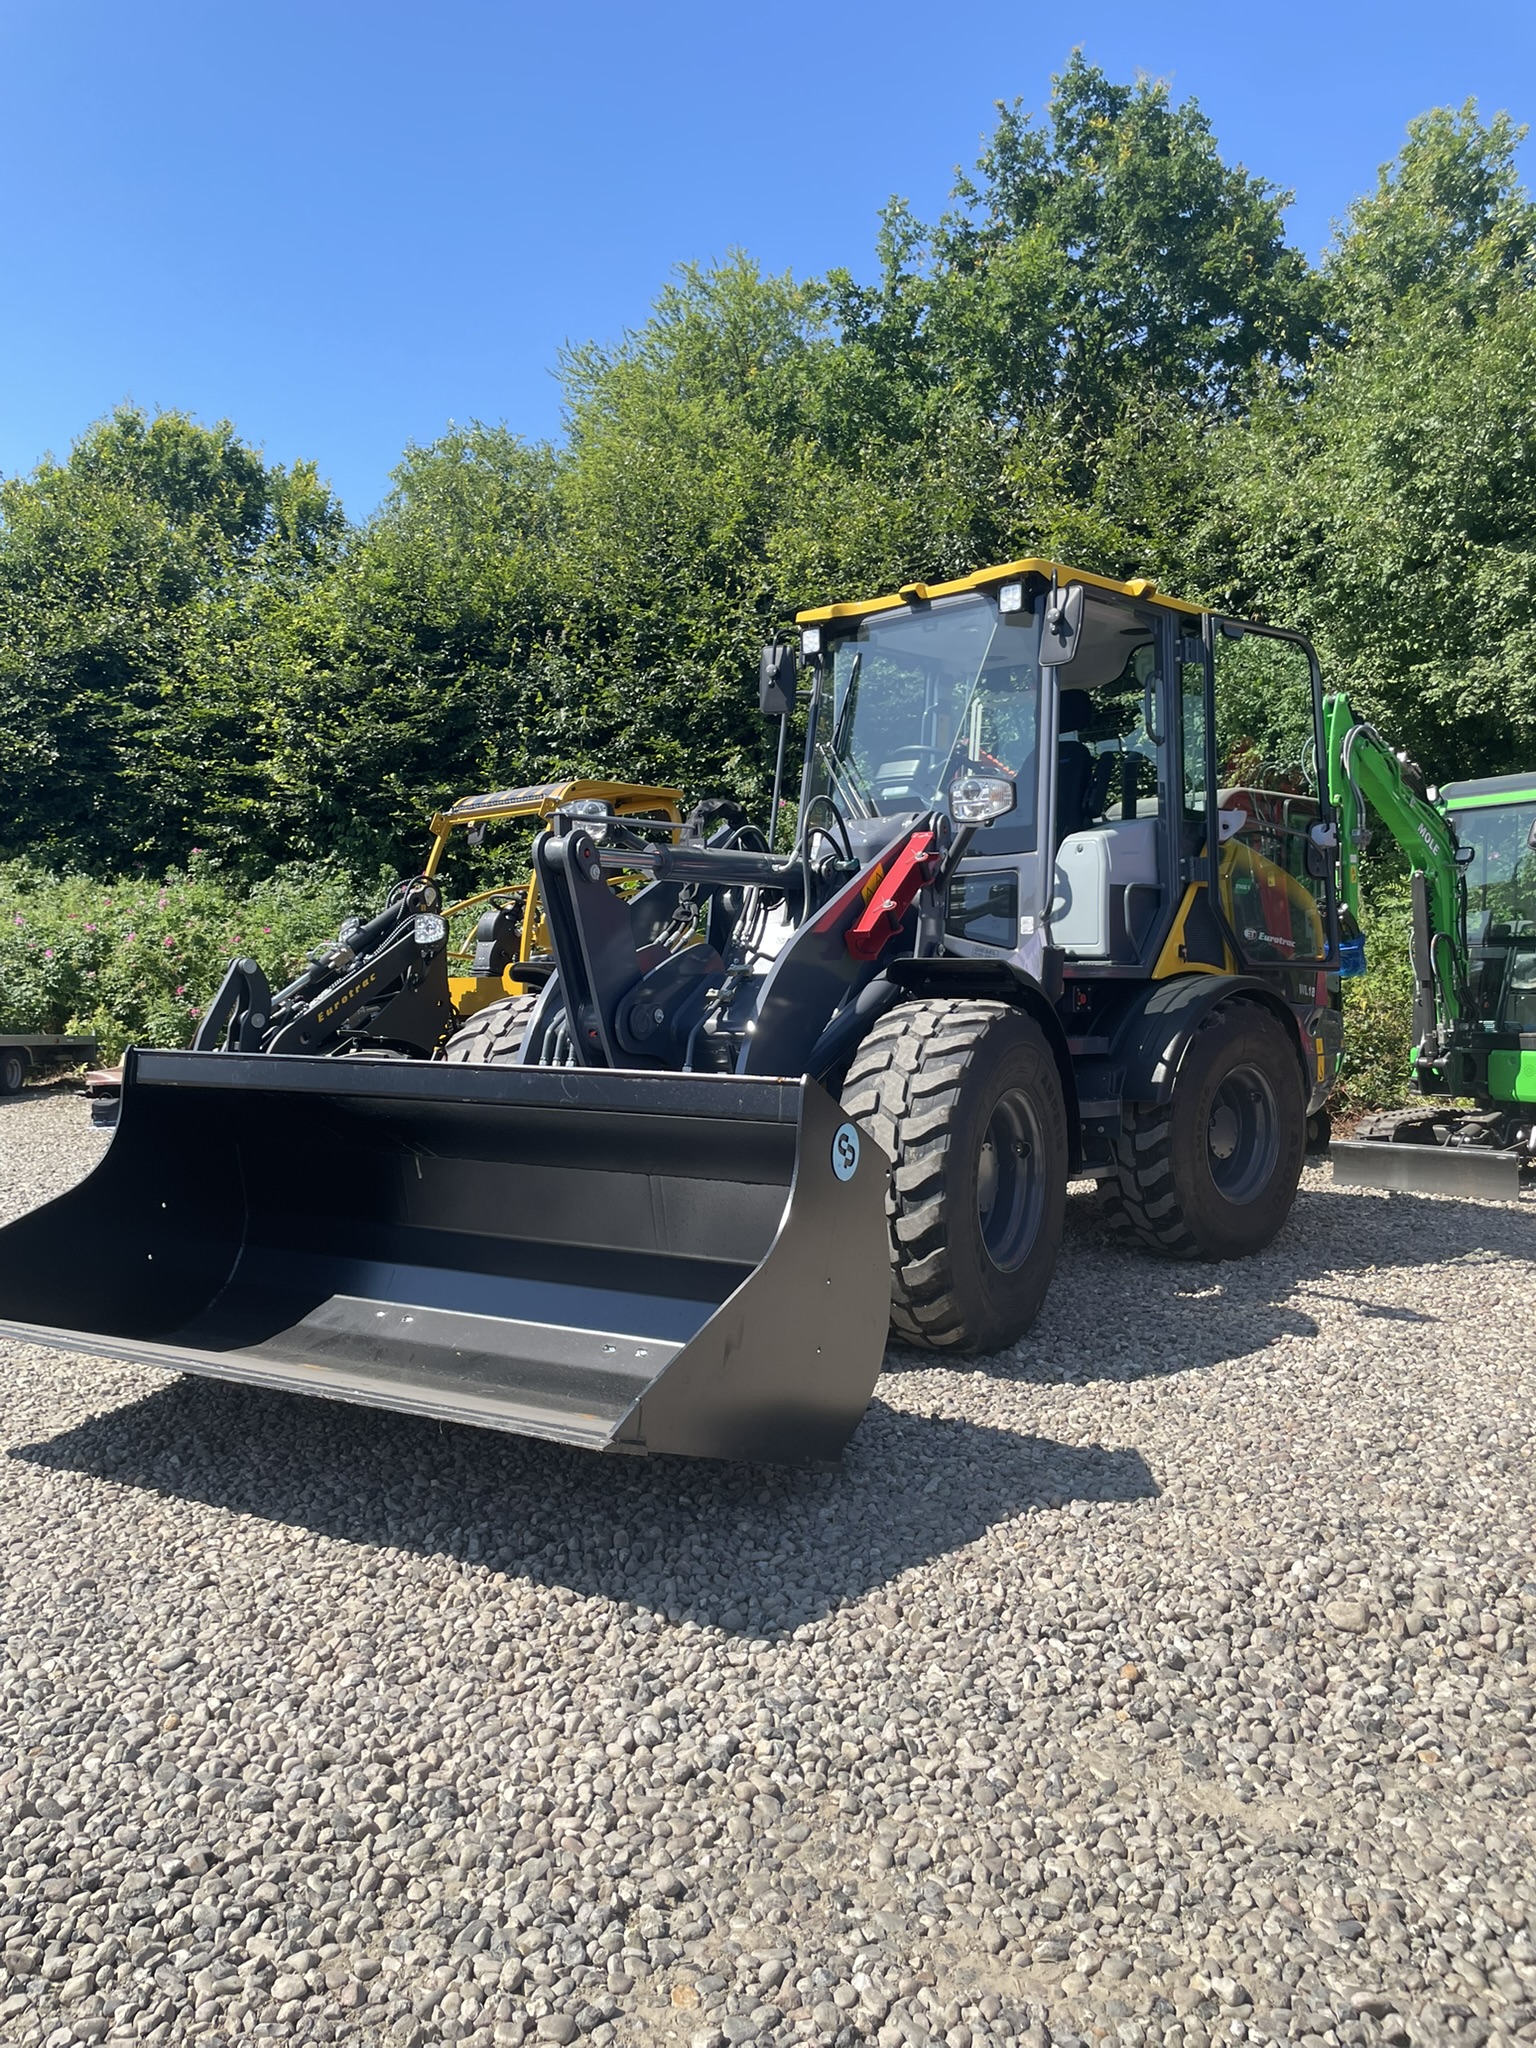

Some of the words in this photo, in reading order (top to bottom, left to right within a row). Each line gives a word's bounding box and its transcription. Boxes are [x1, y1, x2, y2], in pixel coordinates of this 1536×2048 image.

[1417, 822, 1440, 857] MOLE
[1258, 932, 1296, 948] Eurotrac
[318, 972, 376, 1023] Eurotrac
